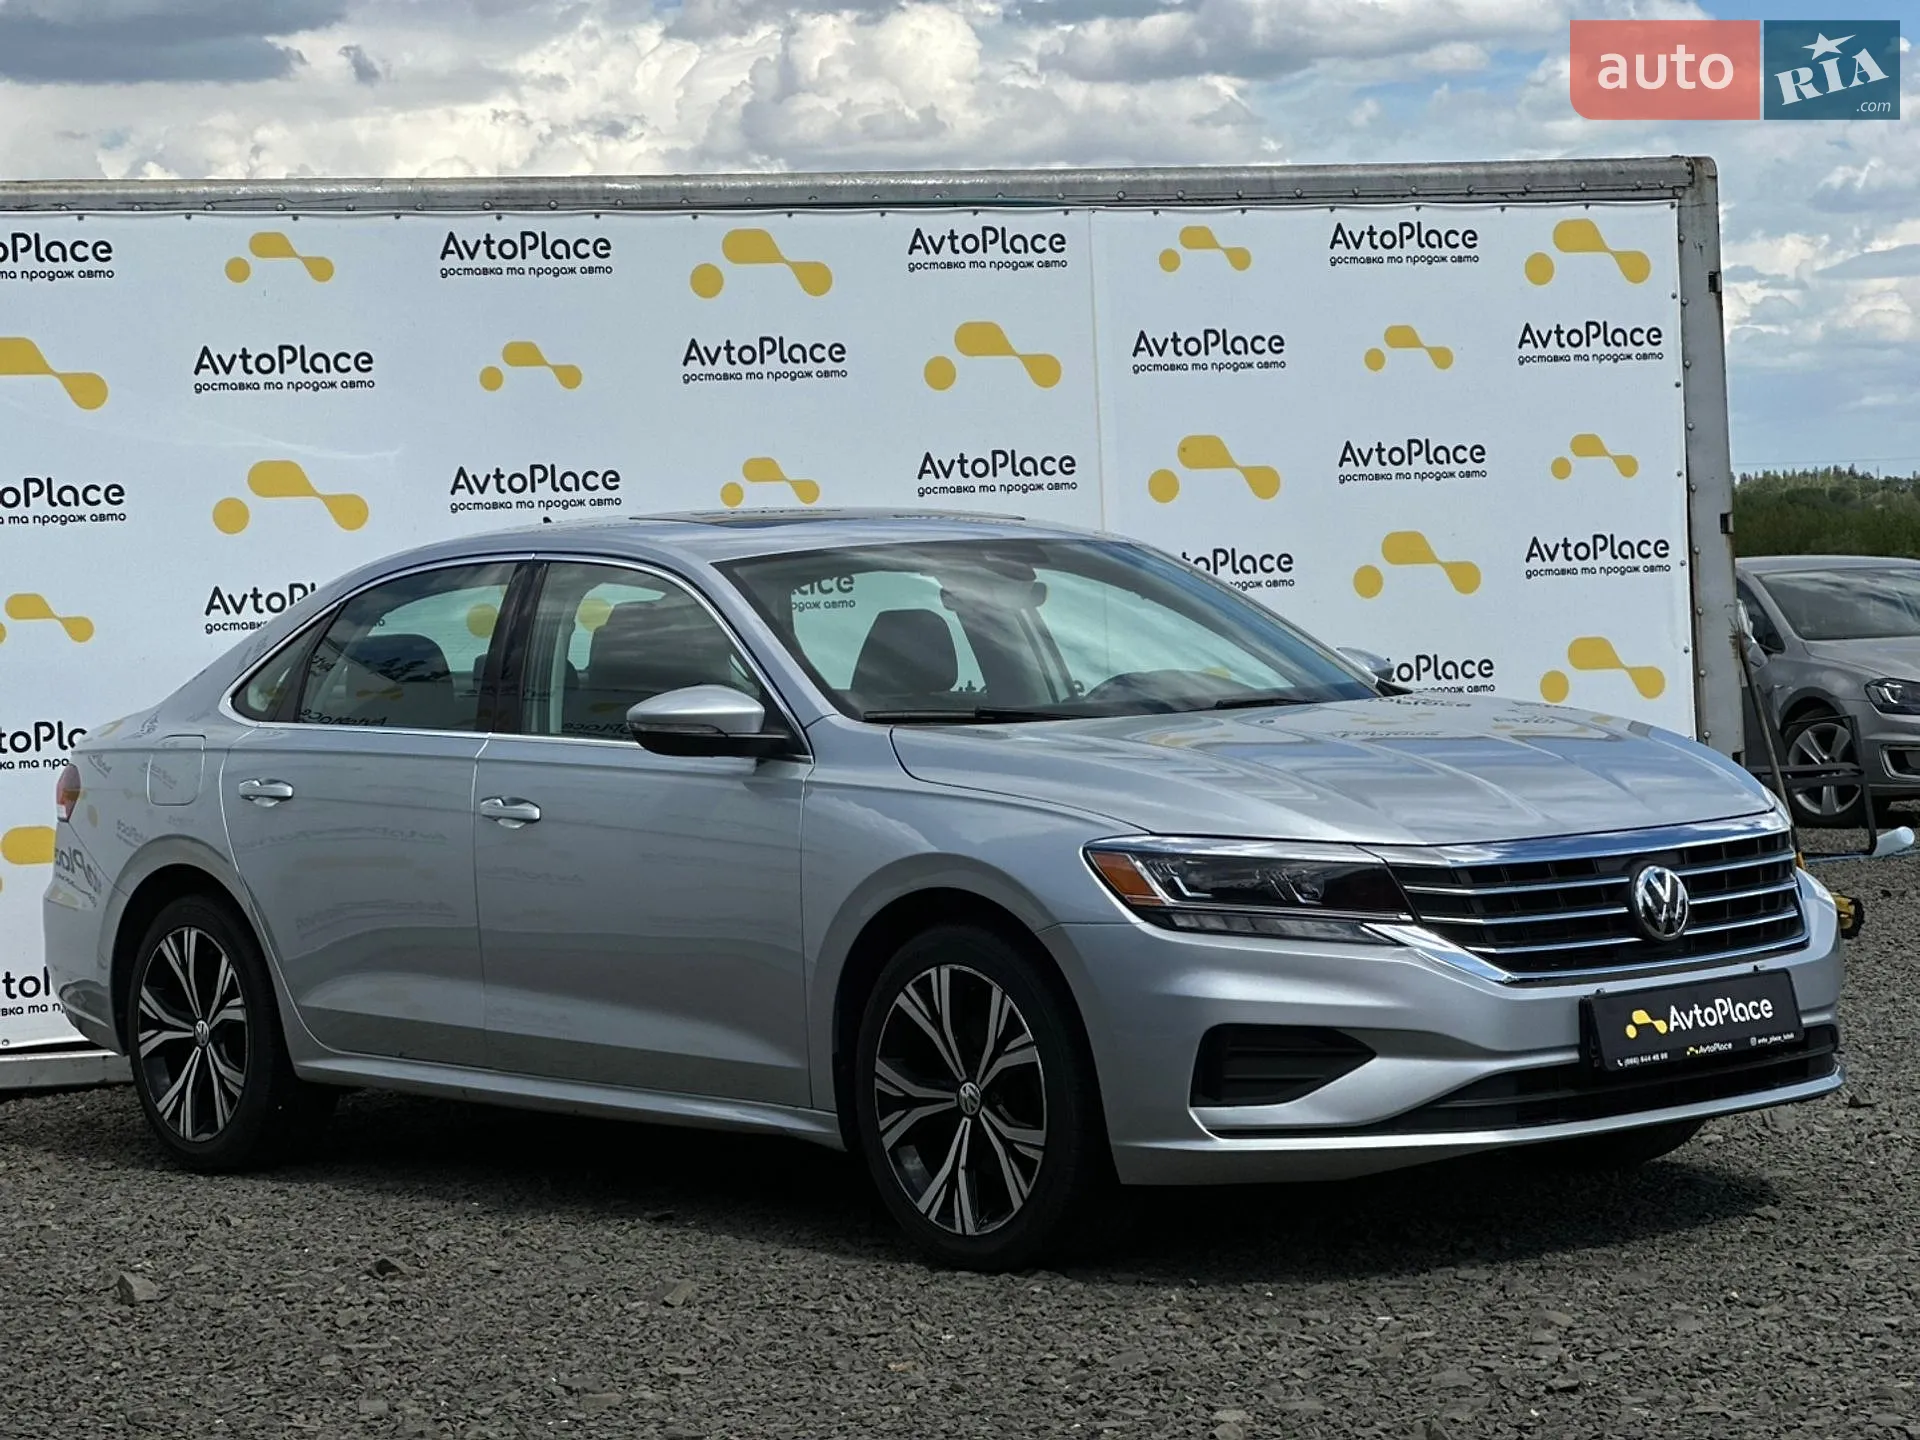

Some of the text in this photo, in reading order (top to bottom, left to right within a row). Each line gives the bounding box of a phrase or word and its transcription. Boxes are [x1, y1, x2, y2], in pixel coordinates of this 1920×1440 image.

[439, 230, 612, 261] AvtoPlace
[907, 225, 1067, 256] AvtoPlace
[1329, 220, 1479, 251] AvtoPlace
[20, 270, 75, 282] продаж
[77, 269, 115, 279] авто
[439, 265, 614, 279] доставка та продаж авто
[907, 259, 1068, 273] доставка та продаж авто
[1329, 254, 1480, 267] доставка та продаж авто
[1131, 328, 1285, 358] AvtoPlace
[1517, 320, 1663, 350] AvtoPlace
[193, 344, 374, 376] AvtoPlace
[682, 335, 847, 367] AvtoPlace
[1517, 351, 1664, 366] доставка та продаж авто
[682, 369, 848, 385] доставка та продаж авто
[1131, 360, 1287, 375] доставка та продаж авто
[193, 379, 376, 395] доставка та продаж авто
[917, 448, 1077, 481] AvtoPlace
[1338, 438, 1486, 469] AvtoPlace
[450, 463, 621, 496] AvtoPlace
[917, 481, 1078, 498] доставка та продаж авто
[1338, 469, 1488, 485] доставка та продаж авто
[0, 476, 126, 509] oPlace
[449, 497, 622, 514] доставка та продаж авто
[7, 515, 30, 525] та
[32, 514, 87, 527] продаж
[89, 512, 127, 523] авто
[1525, 533, 1670, 564] AvtoPlace
[1525, 564, 1672, 580] доставка та продаж авто
[1391, 653, 1495, 683] oPlace
[1668, 997, 1774, 1033] AvtoPlace
